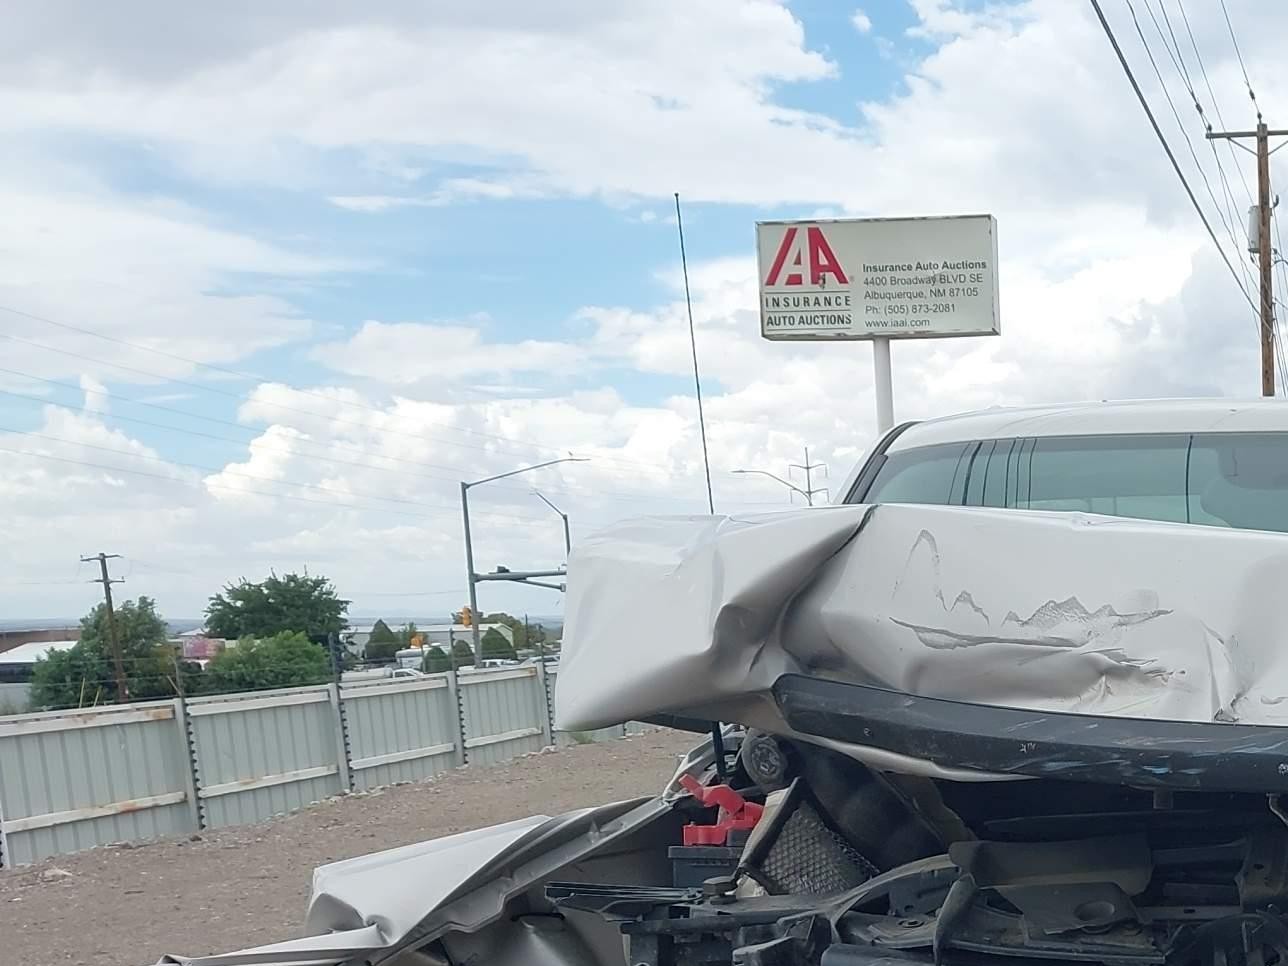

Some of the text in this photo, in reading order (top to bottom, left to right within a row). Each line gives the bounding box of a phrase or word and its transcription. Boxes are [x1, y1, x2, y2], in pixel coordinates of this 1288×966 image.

[862, 259, 987, 273] Insurance Auto Auctions
[863, 272, 984, 287] 4400 Broadway BLVD SE
[863, 286, 979, 301] Albuquerque, NM 87105
[765, 295, 851, 308] INSURANCE
[865, 302, 956, 316] Ph: (505) 873-2081
[766, 313, 852, 327] AUTO AUCTIONS
[864, 318, 931, 328] www.iaai.com
